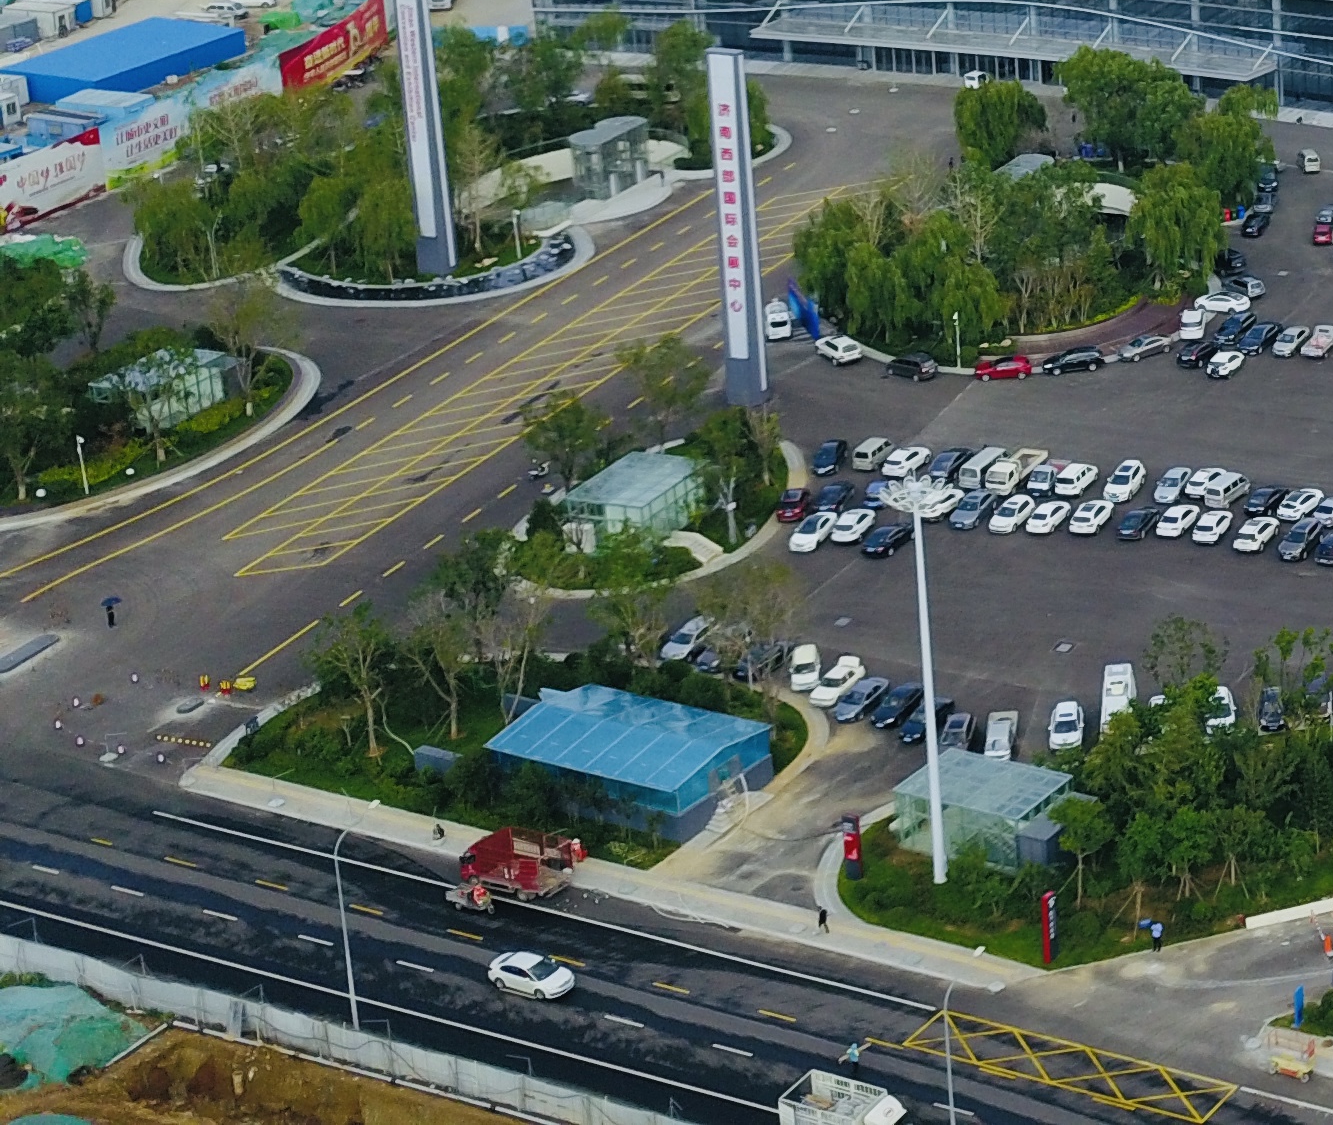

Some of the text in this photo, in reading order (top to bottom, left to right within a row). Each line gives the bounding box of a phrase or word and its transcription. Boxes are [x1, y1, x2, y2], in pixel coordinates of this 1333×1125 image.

[717, 103, 743, 313] 济南西部国际会展中心
